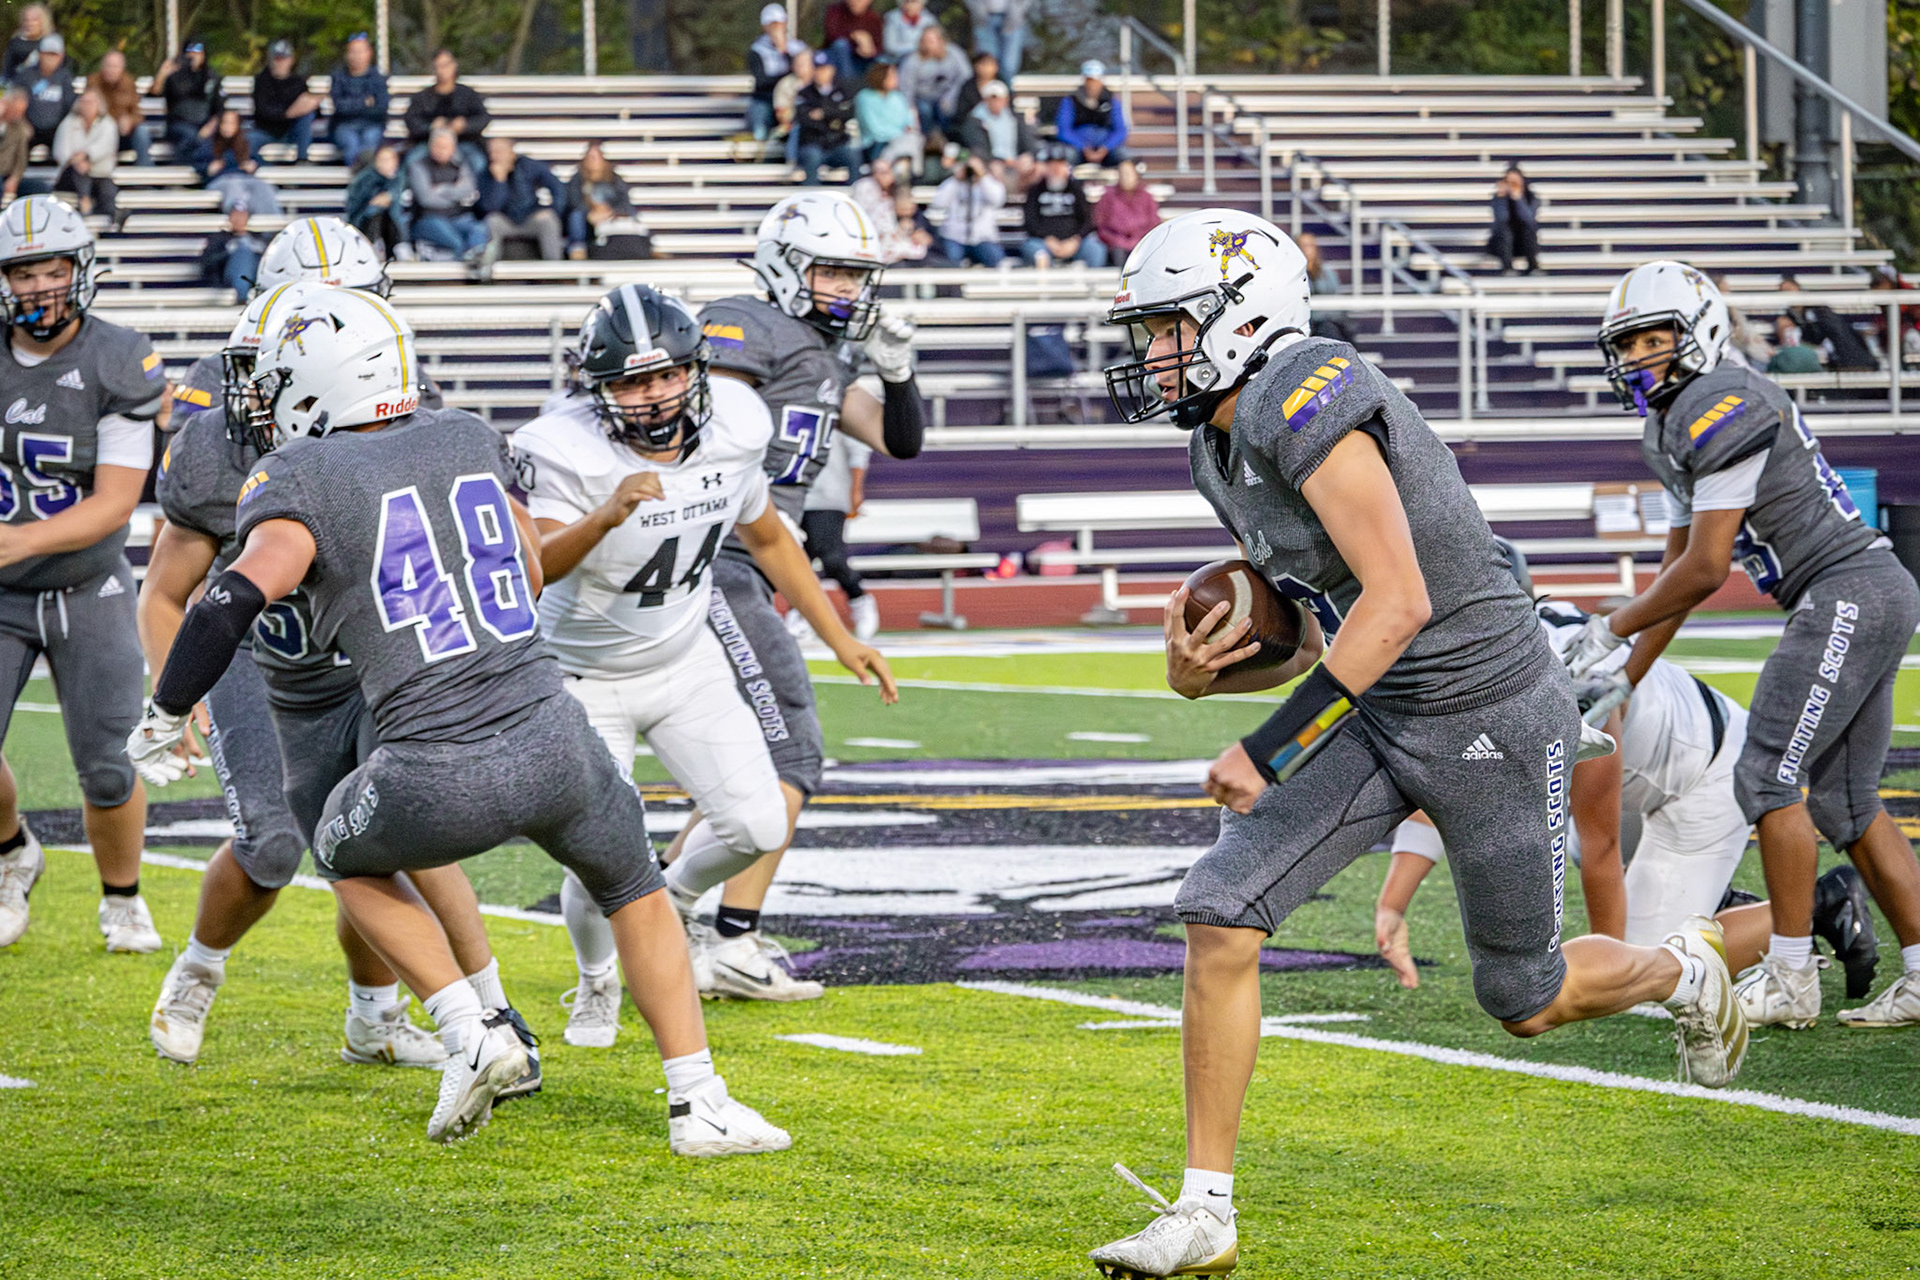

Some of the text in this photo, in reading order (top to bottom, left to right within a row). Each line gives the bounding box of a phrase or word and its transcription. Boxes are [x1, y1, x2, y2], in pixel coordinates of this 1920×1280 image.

[376, 397, 420, 418] Ridde
[640, 497, 728, 528] WEST OTTAWA
[370, 471, 538, 664] 48
[622, 521, 724, 609] 44
[745, 678, 790, 743] SCOTS
[1777, 600, 1860, 786] FIGHTING SCOTS
[1461, 749, 1504, 761] adidas
[1546, 738, 1565, 831] SCOTS
